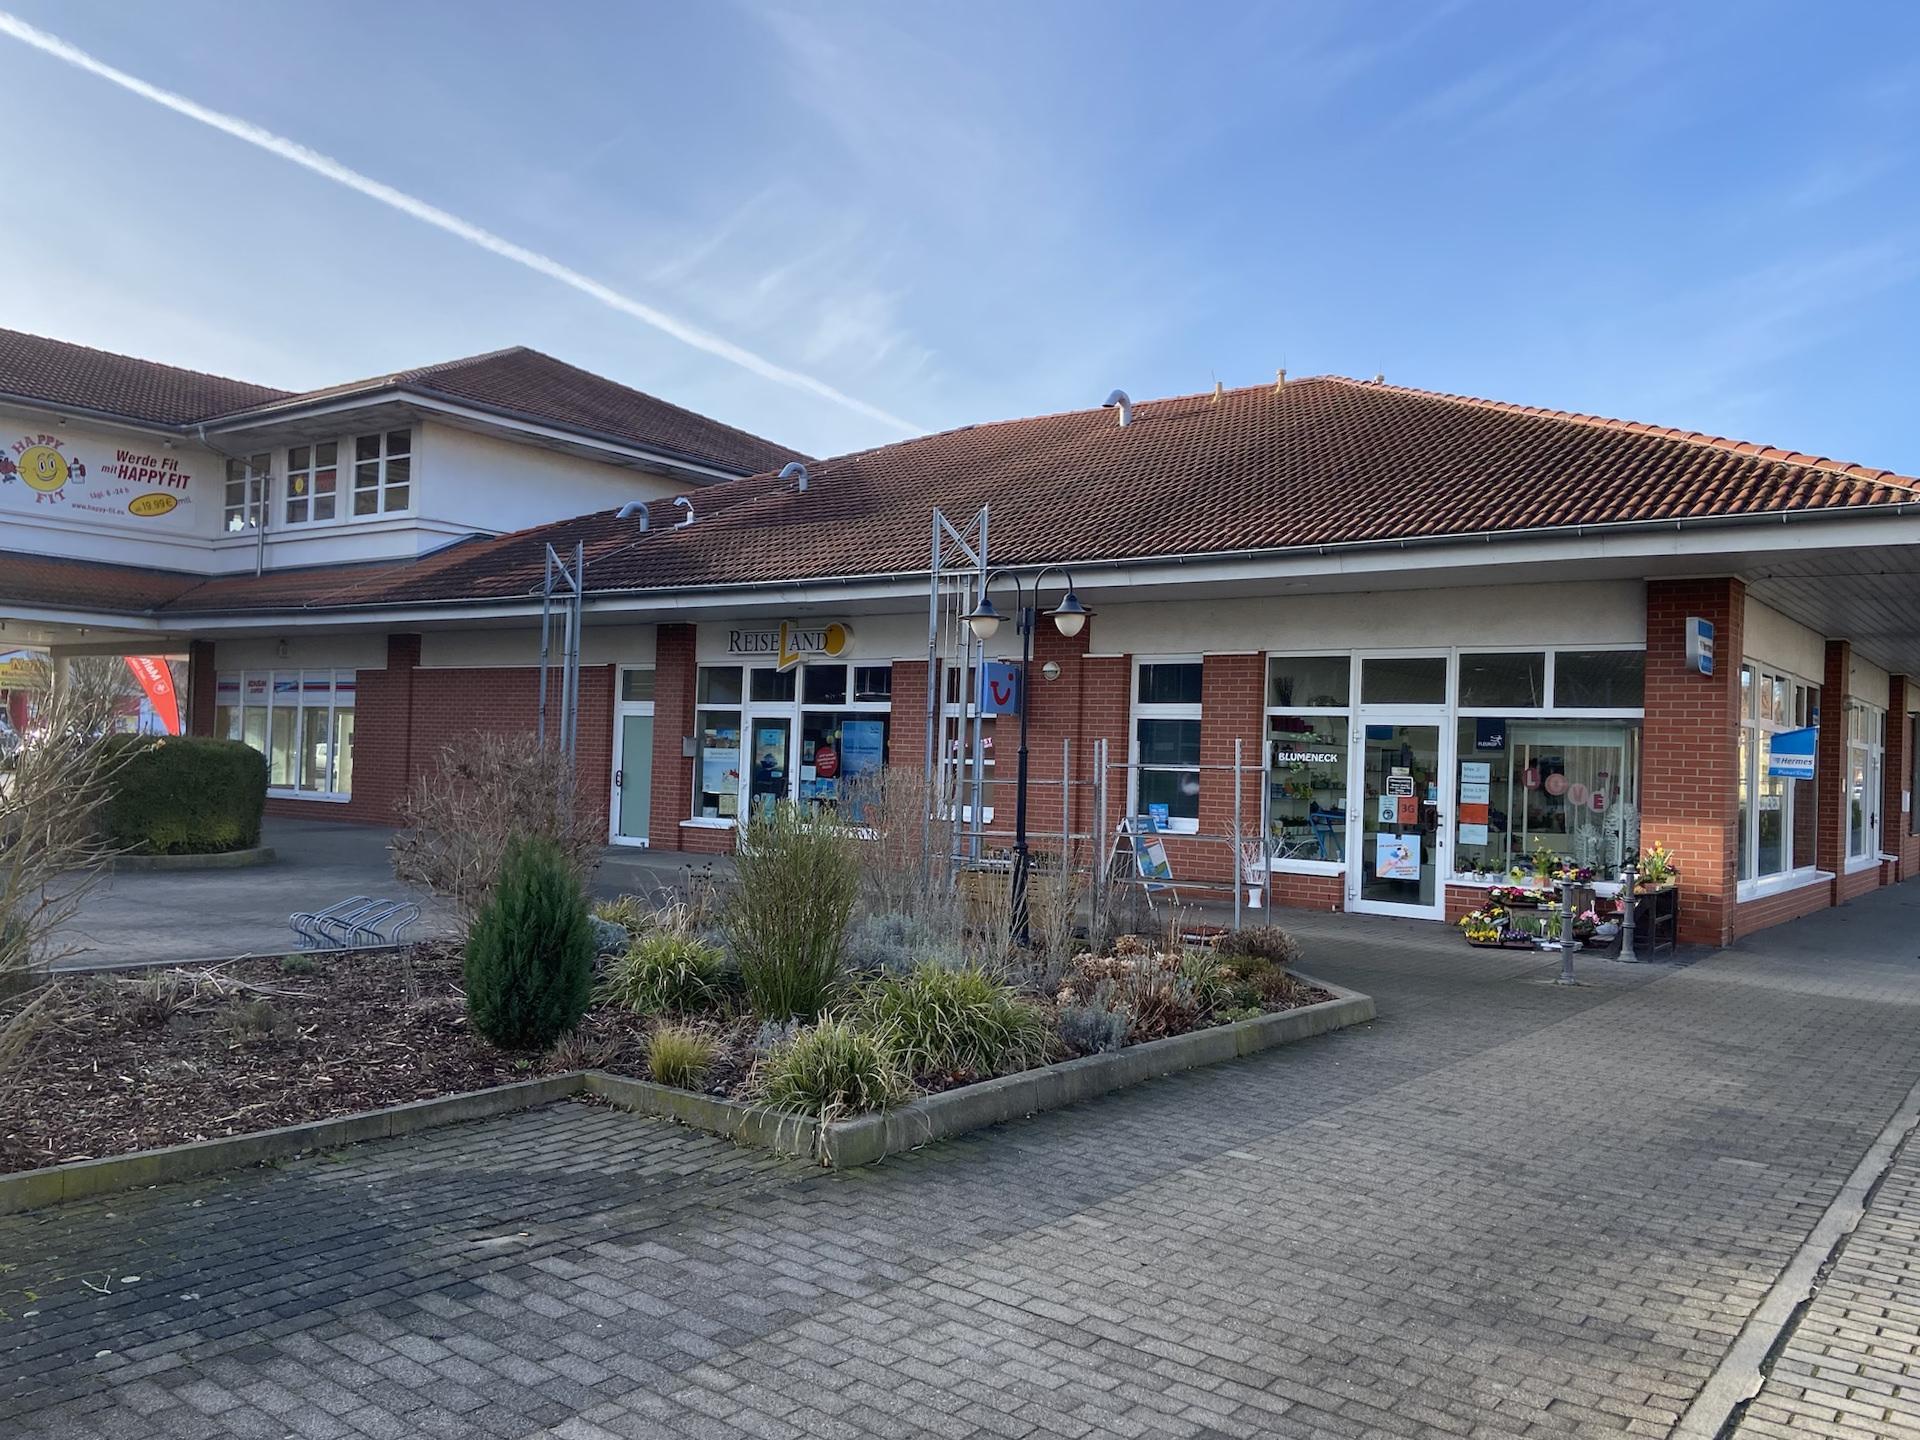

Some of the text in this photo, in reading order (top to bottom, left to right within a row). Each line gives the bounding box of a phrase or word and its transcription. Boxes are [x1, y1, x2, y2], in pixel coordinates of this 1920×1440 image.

[12, 434, 65, 455] HAPPY
[116, 449, 179, 472] Werde Fit
[101, 464, 191, 490] mit HAPPY FIT
[36, 489, 66, 504] FIT
[1278, 752, 1338, 763] BLUMENECK
[1781, 757, 1814, 766] Hermes
[1401, 804, 1415, 813] 3G
